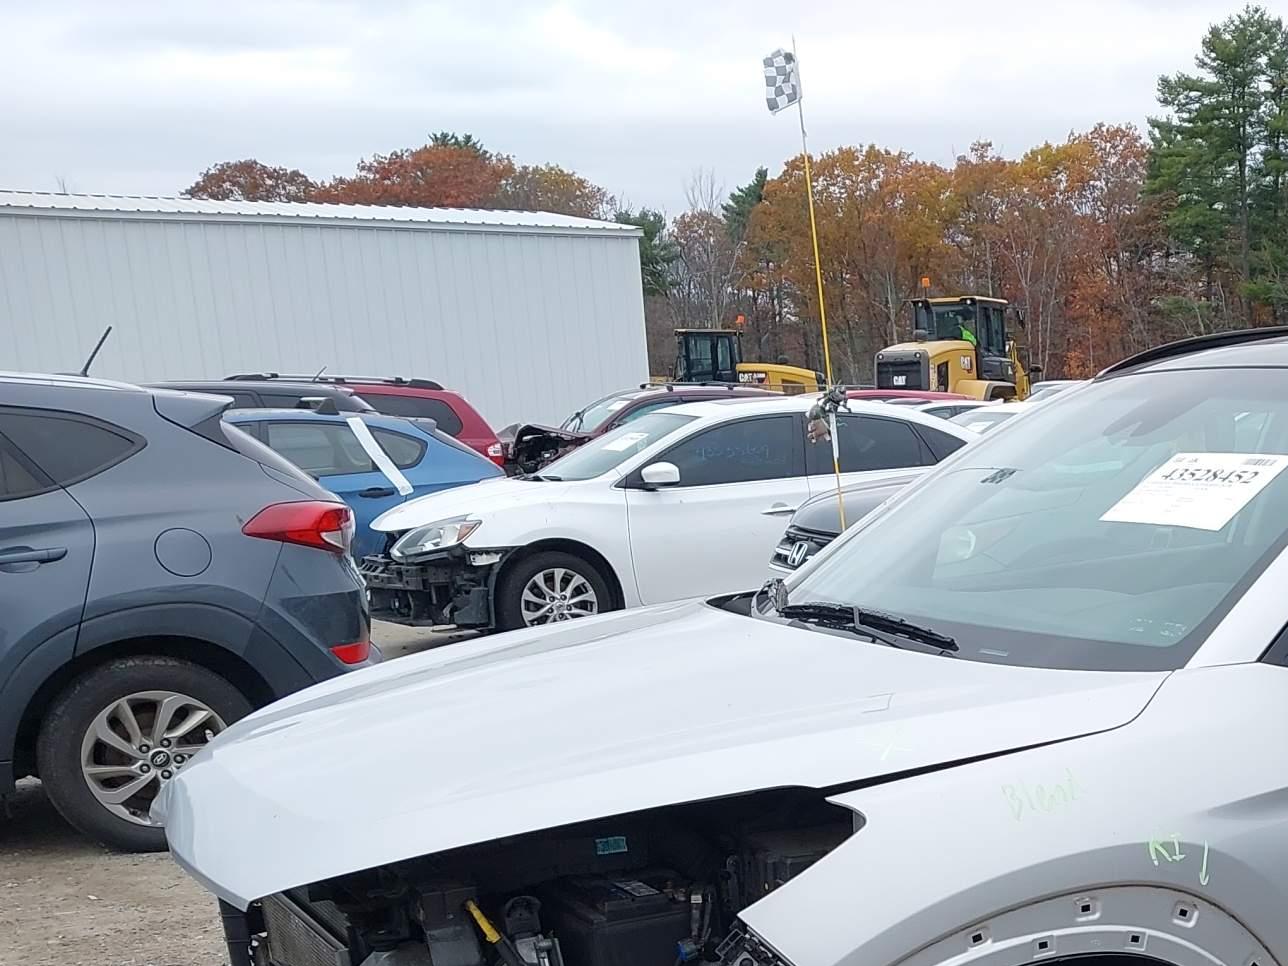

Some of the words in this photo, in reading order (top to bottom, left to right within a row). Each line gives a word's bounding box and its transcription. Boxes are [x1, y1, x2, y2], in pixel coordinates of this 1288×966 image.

[959, 356, 972, 370] CAT
[739, 373, 753, 383] CAT
[893, 375, 907, 386] CAT
[1161, 468, 1259, 484] 43528452
